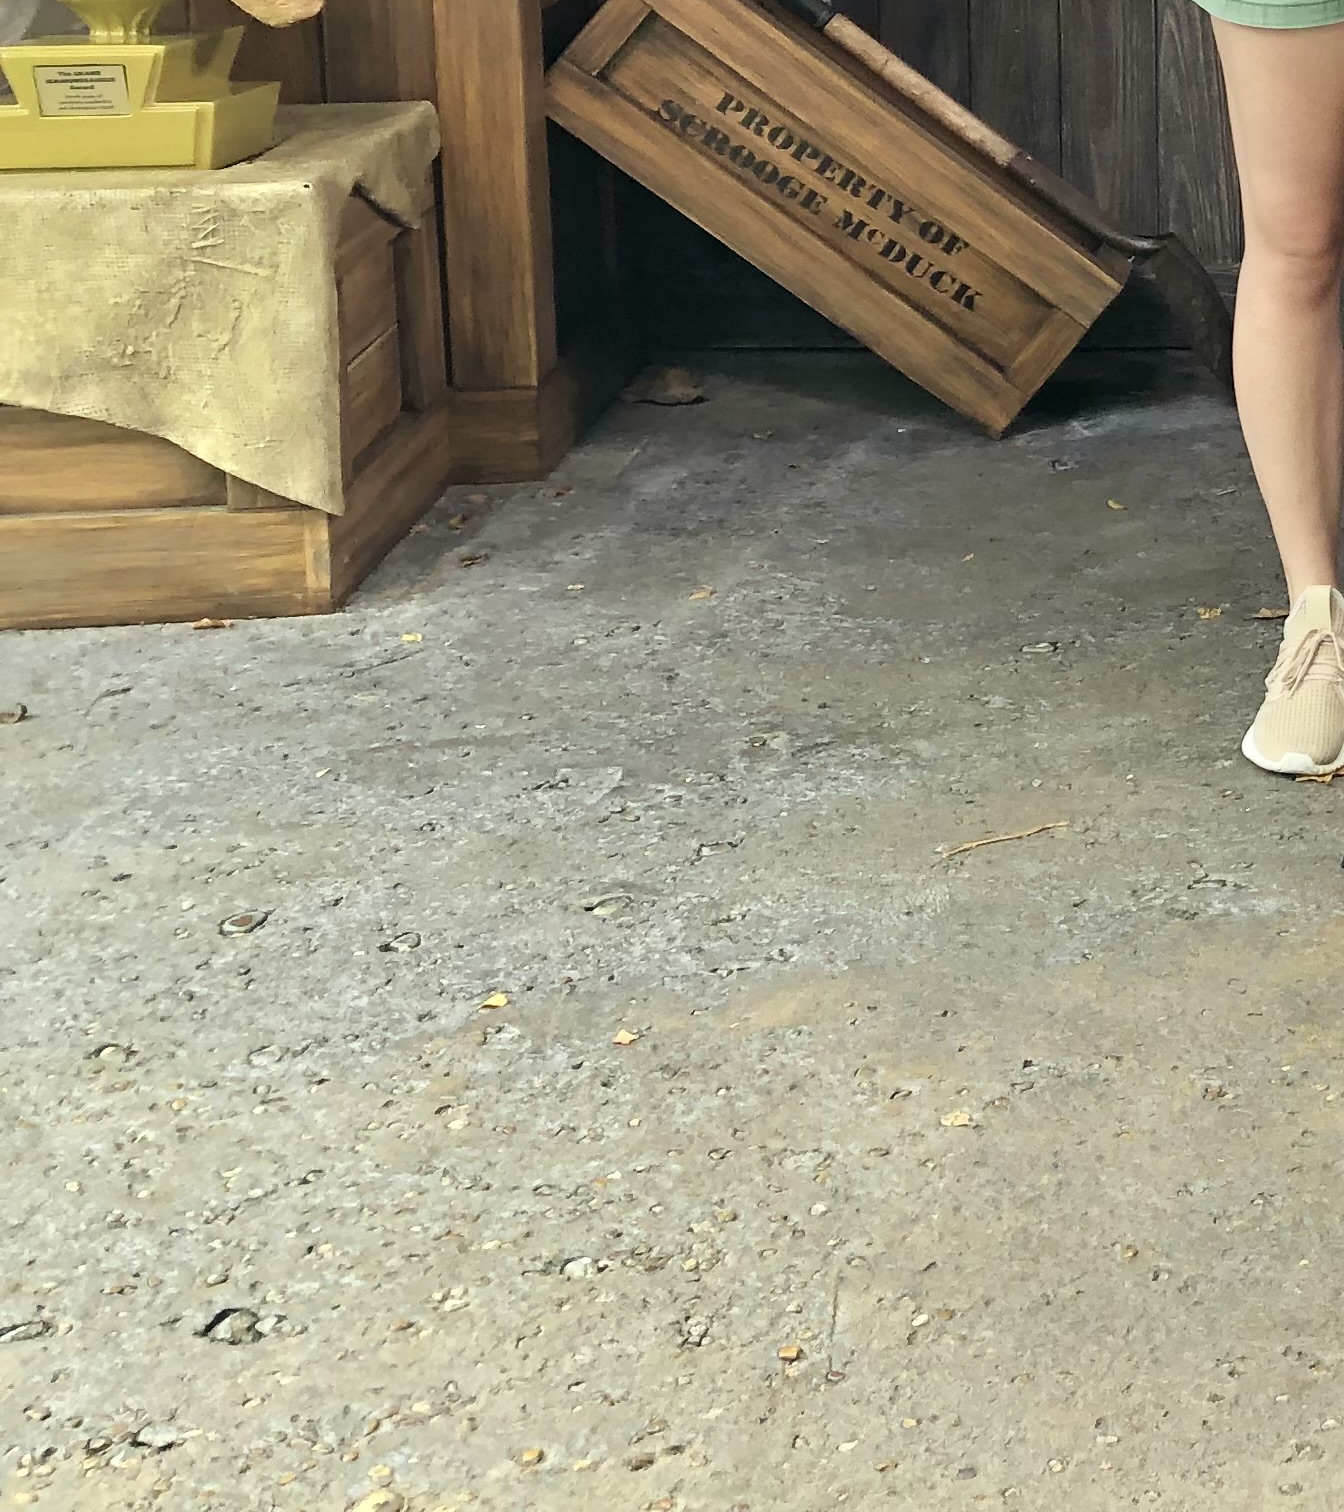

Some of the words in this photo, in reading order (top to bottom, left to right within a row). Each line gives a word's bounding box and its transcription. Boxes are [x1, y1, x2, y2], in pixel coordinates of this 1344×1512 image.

[656, 99, 828, 216] SCROOGE
[715, 92, 915, 224] PROPERTY
[917, 220, 970, 257] OF
